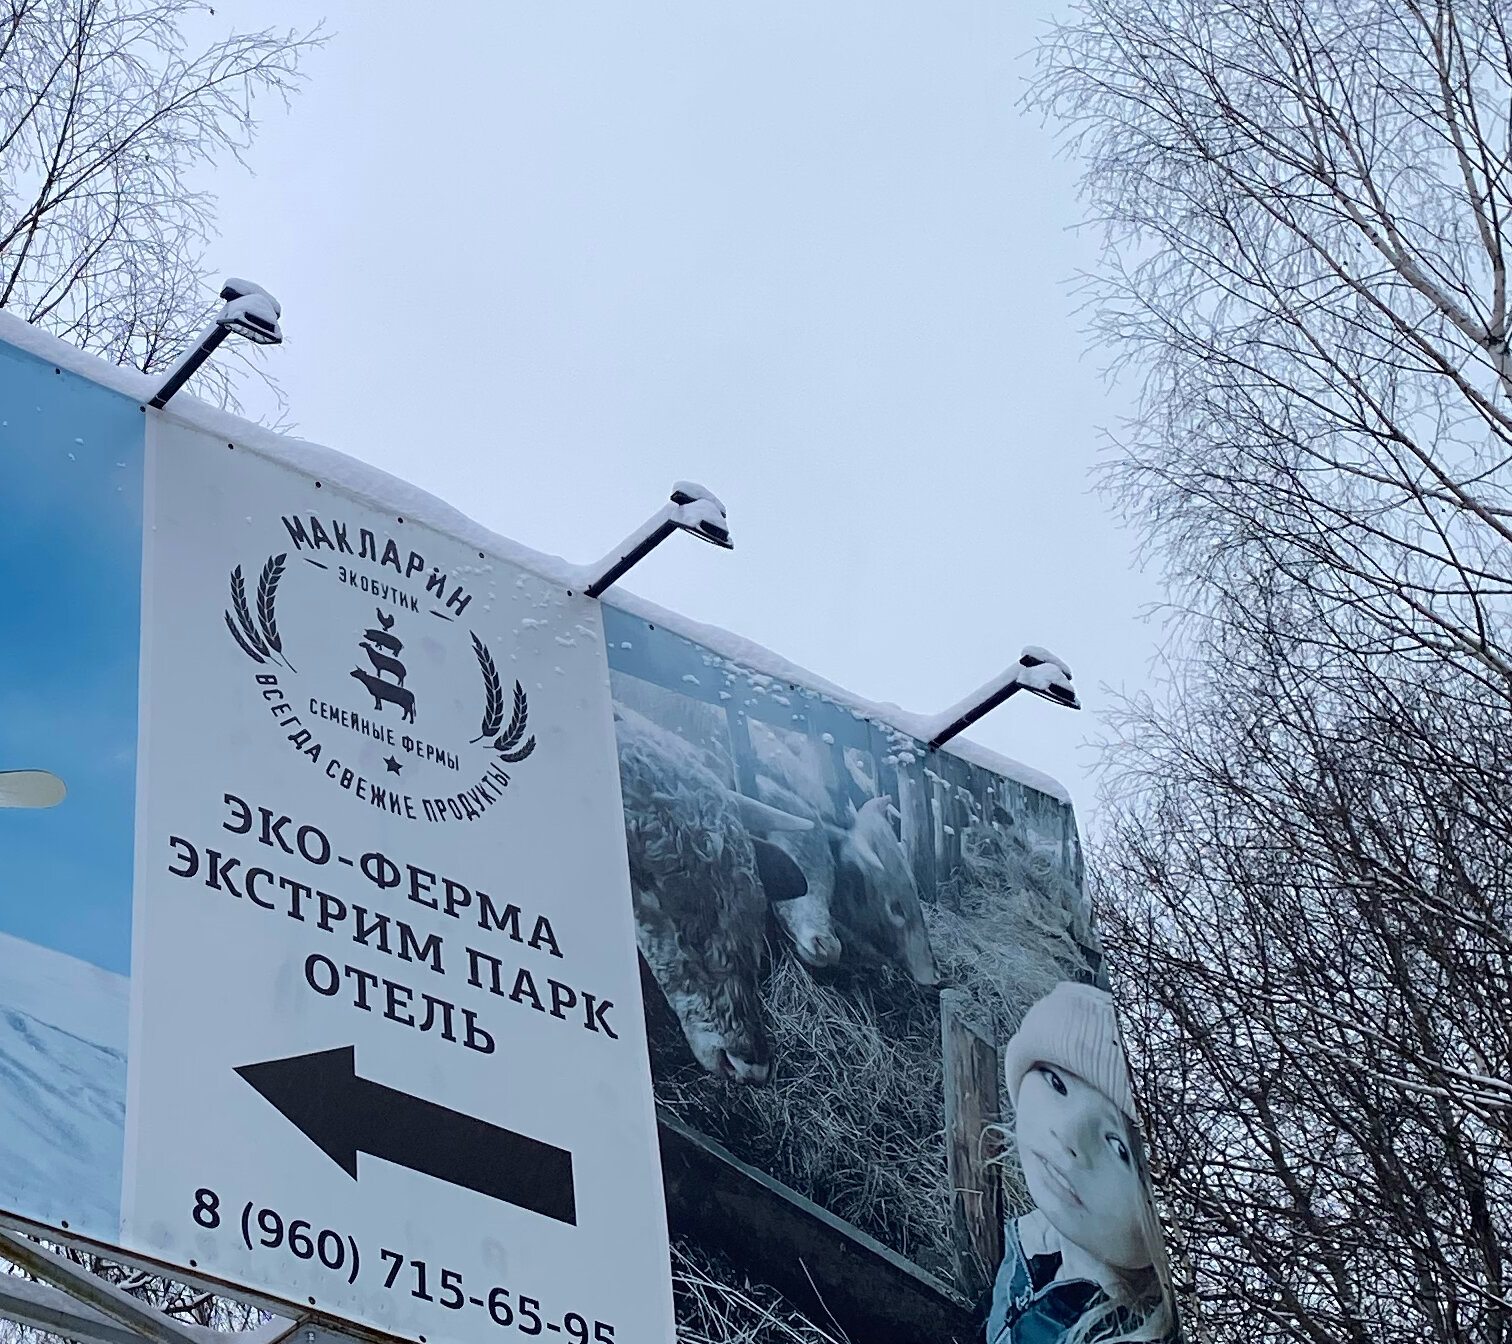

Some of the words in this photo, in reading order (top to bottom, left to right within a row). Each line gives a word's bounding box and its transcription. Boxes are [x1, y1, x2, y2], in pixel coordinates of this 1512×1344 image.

[280, 515, 473, 617] МАКЛАРИН
[338, 565, 420, 614] ЭКОБУТИК
[254, 674, 322, 764] ВСЕГДА
[325, 759, 417, 820] СВЕЖИЕ
[421, 761, 512, 823] ПРОДУКТЫ
[309, 697, 396, 747] СЕМЕЙНЫЕ
[401, 735, 460, 772] ФЕРМЫ
[222, 793, 564, 959] ЭКО-ФЕРМА
[168, 835, 446, 975] ЭКСТРИМ
[465, 946, 619, 1040] ПАРК
[304, 953, 496, 1055] ОТЕЛЬ
[192, 1187, 221, 1230] 8
[241, 1201, 360, 1285] (960)
